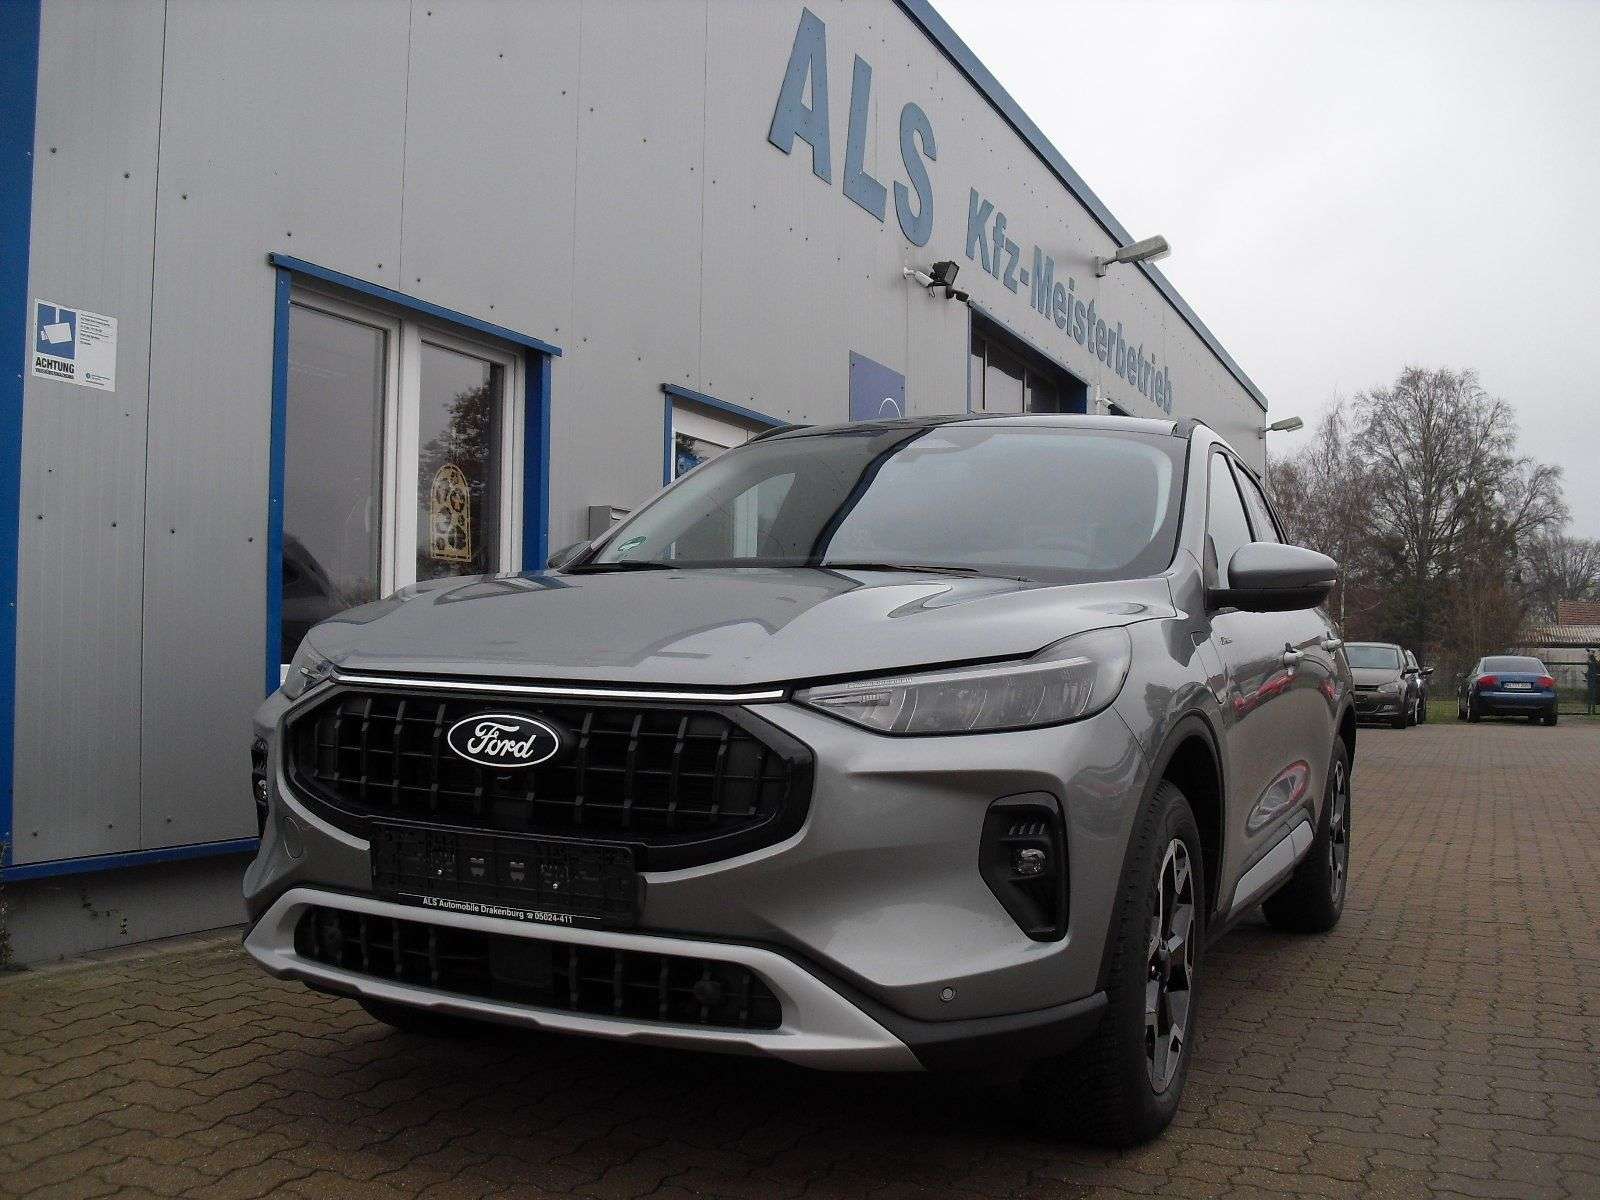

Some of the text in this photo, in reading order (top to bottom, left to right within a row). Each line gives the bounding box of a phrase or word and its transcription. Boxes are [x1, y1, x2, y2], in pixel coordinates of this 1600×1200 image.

[768, 7, 937, 248] ALS
[965, 186, 1173, 416] Kfz-Meisterbetrieb
[35, 356, 75, 374] ACHTUNG
[467, 721, 536, 758] Ford
[422, 896, 438, 907] ALS
[438, 899, 480, 913] Automobile
[480, 905, 524, 920] Drakenburg
